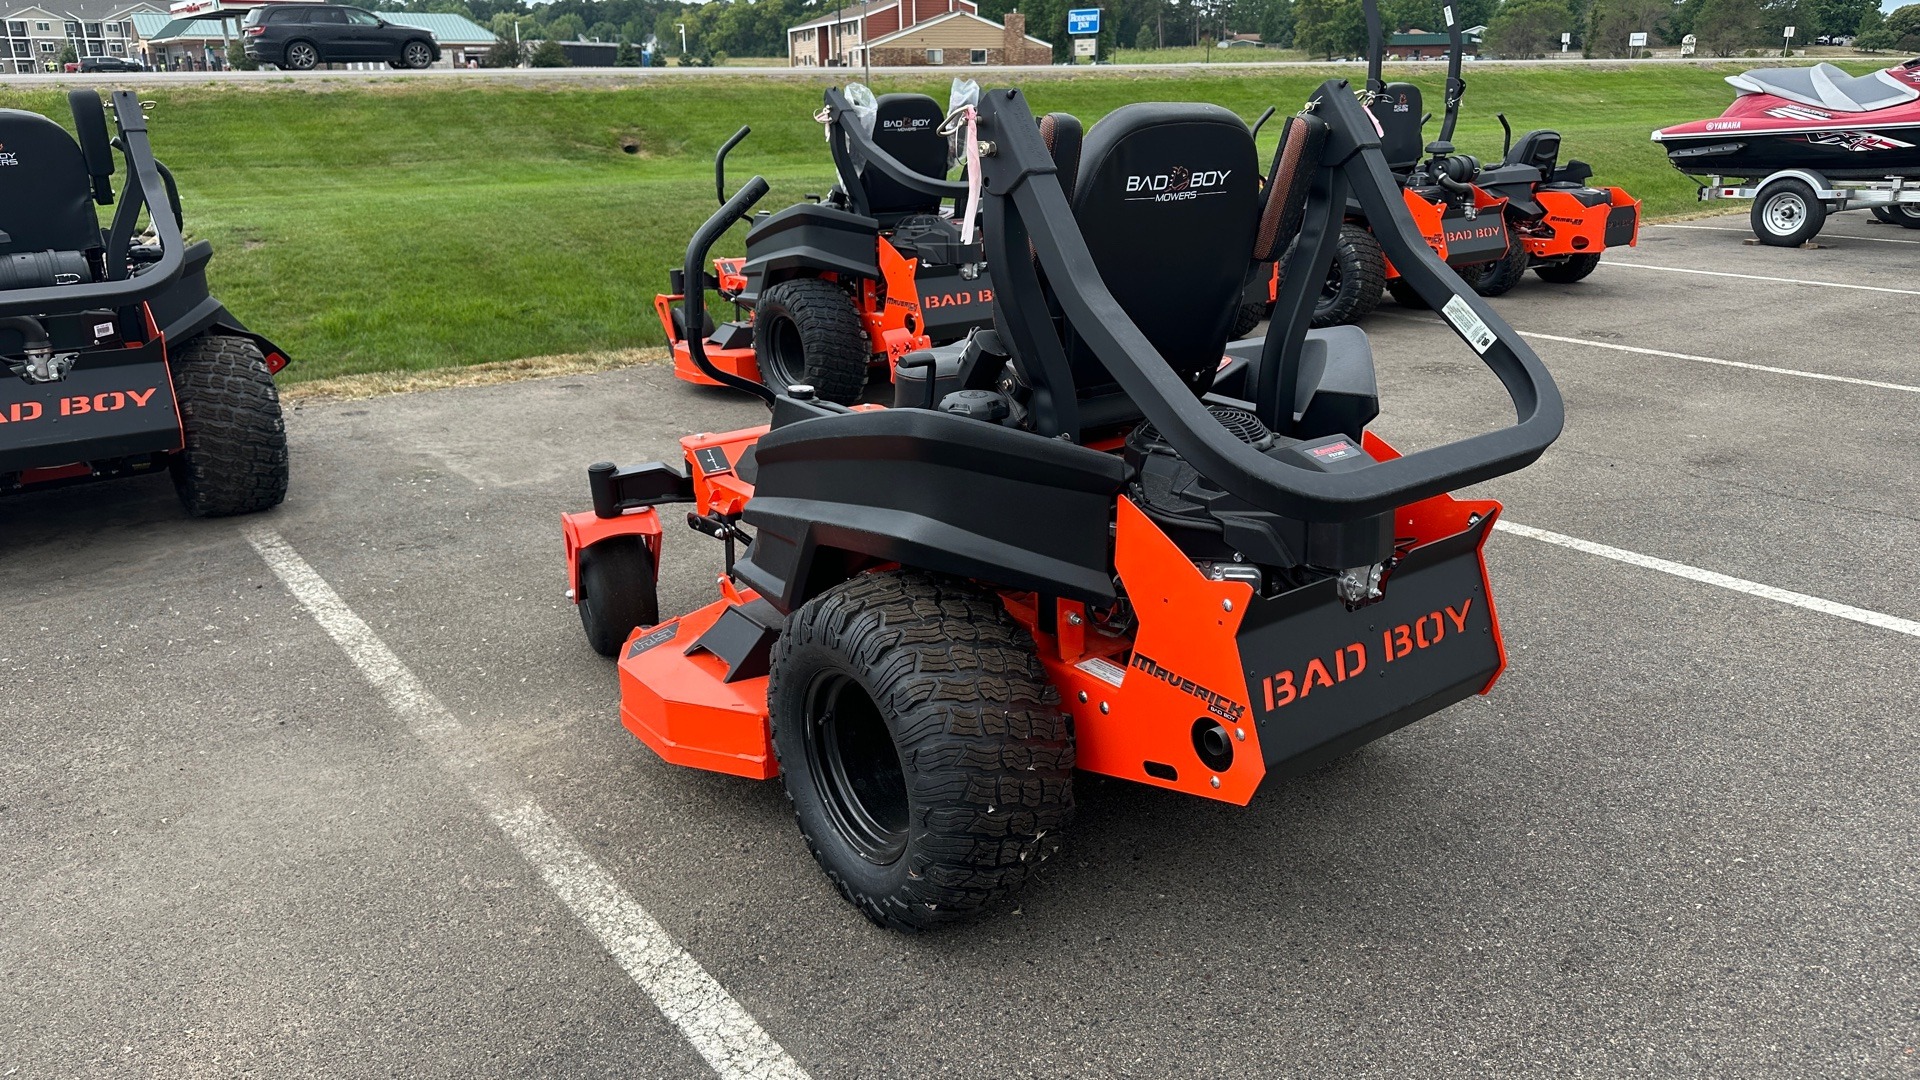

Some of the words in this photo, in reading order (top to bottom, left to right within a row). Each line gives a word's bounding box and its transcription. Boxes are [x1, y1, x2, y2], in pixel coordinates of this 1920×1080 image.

[883, 120, 903, 128] BAD
[1714, 121, 1742, 130] YAMAHA
[0, 152, 16, 160] OY
[1126, 175, 1169, 192] BAD
[1190, 170, 1232, 188] BOY
[1155, 190, 1197, 202] MOWERS
[1446, 229, 1473, 242] BAD
[1475, 226, 1500, 238] BOY
[924, 292, 971, 309] BAD
[60, 387, 157, 416] BOY
[1262, 641, 1368, 713] BAD
[1383, 597, 1474, 663] BOY
[1131, 651, 1246, 718] MAVERICK
[1209, 705, 1223, 716] BAD
[1223, 711, 1236, 721] BOY
